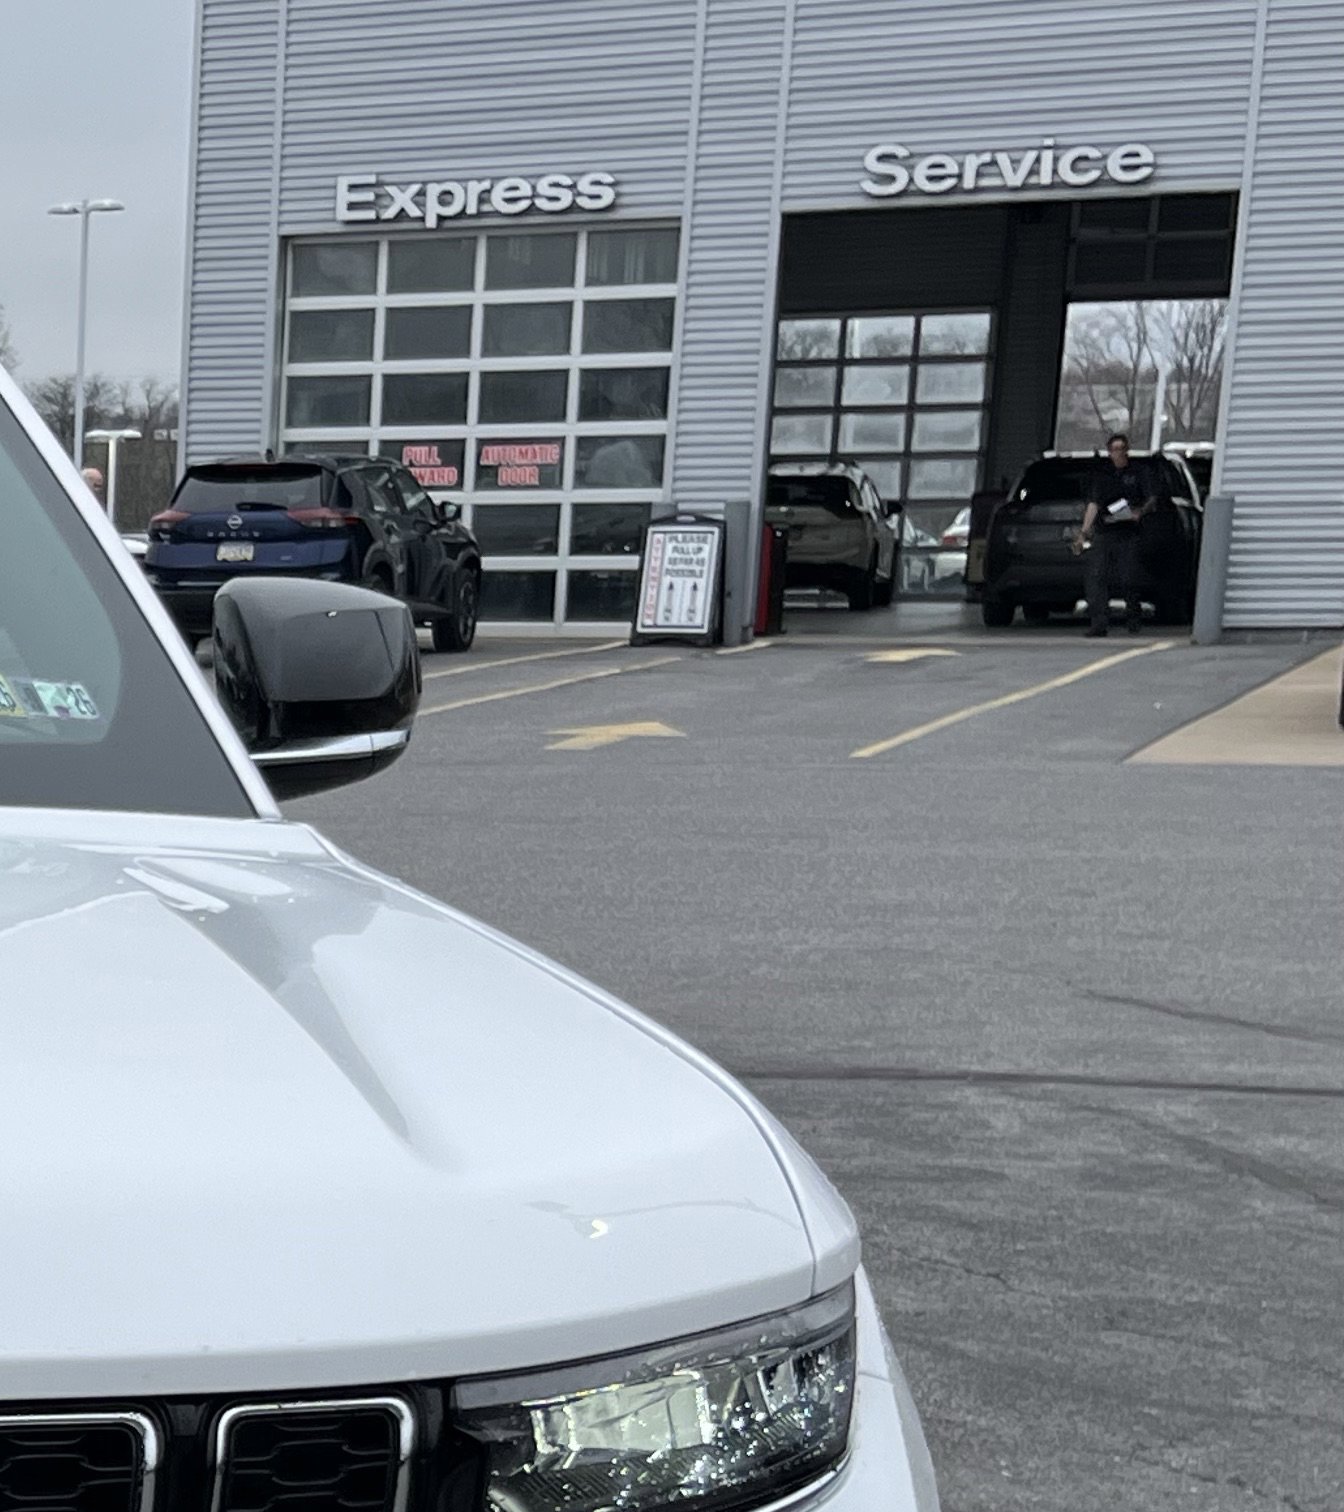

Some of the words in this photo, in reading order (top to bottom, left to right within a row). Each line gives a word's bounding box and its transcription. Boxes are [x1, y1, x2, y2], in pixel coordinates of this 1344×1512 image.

[860, 138, 1156, 197] Service
[335, 172, 616, 229] Express
[402, 445, 441, 466] PULL
[480, 444, 560, 466] AUTOMATIC
[498, 466, 540, 486] DOOR
